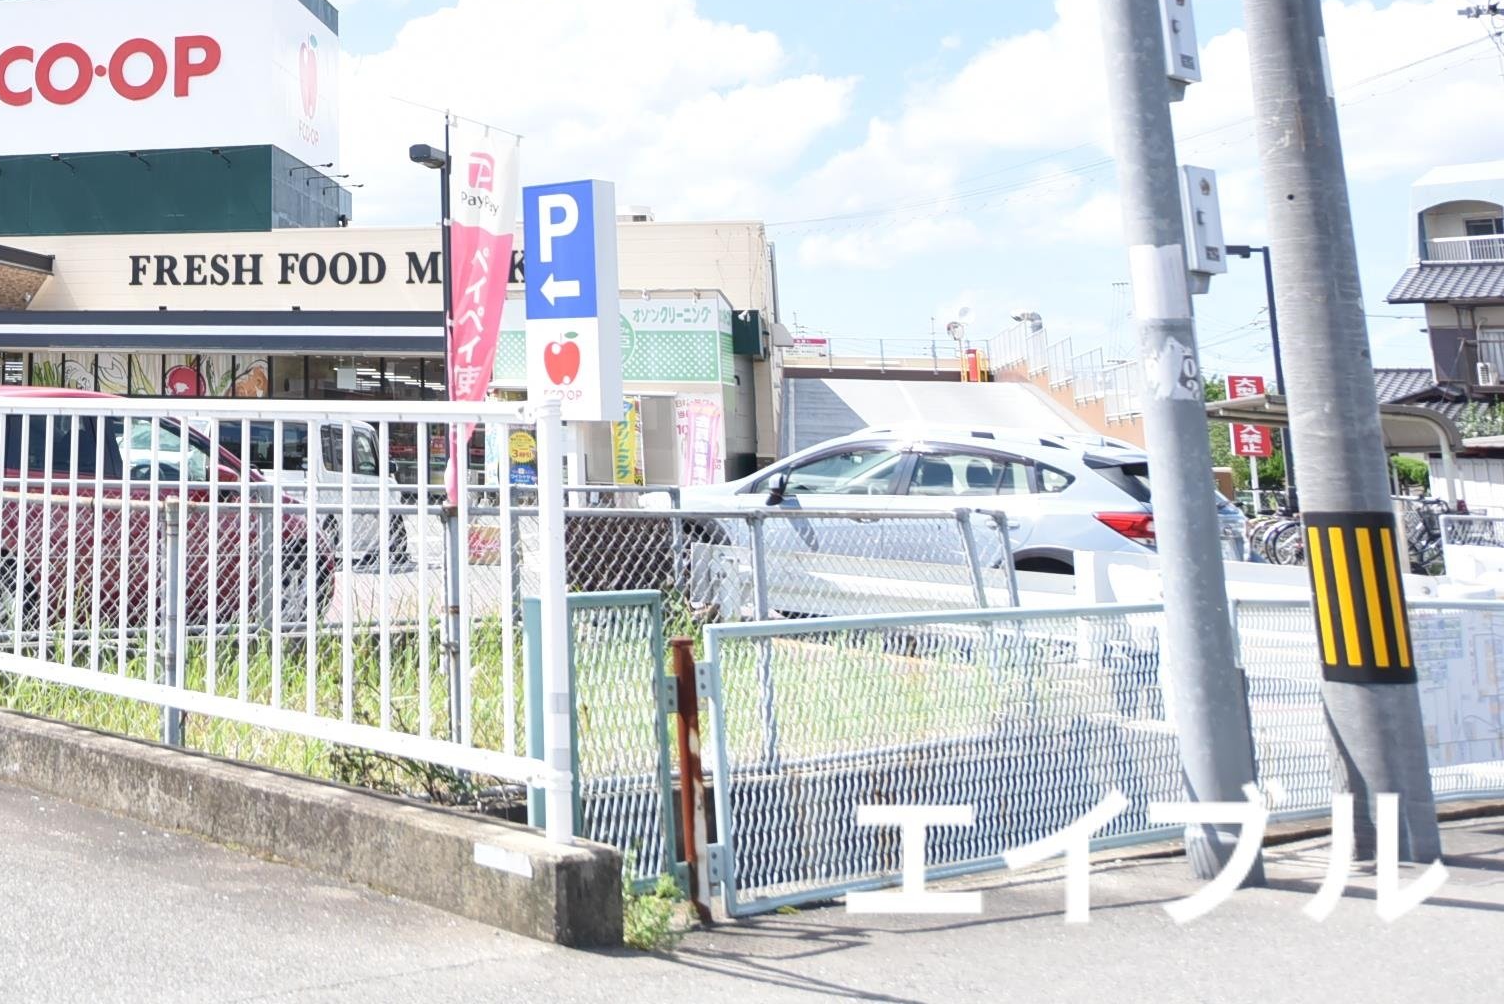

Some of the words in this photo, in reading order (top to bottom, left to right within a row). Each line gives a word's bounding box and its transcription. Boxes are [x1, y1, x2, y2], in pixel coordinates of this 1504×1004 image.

[538, 193, 579, 263] P
[128, 254, 263, 286] FRESH
[277, 251, 386, 285] FOOD
